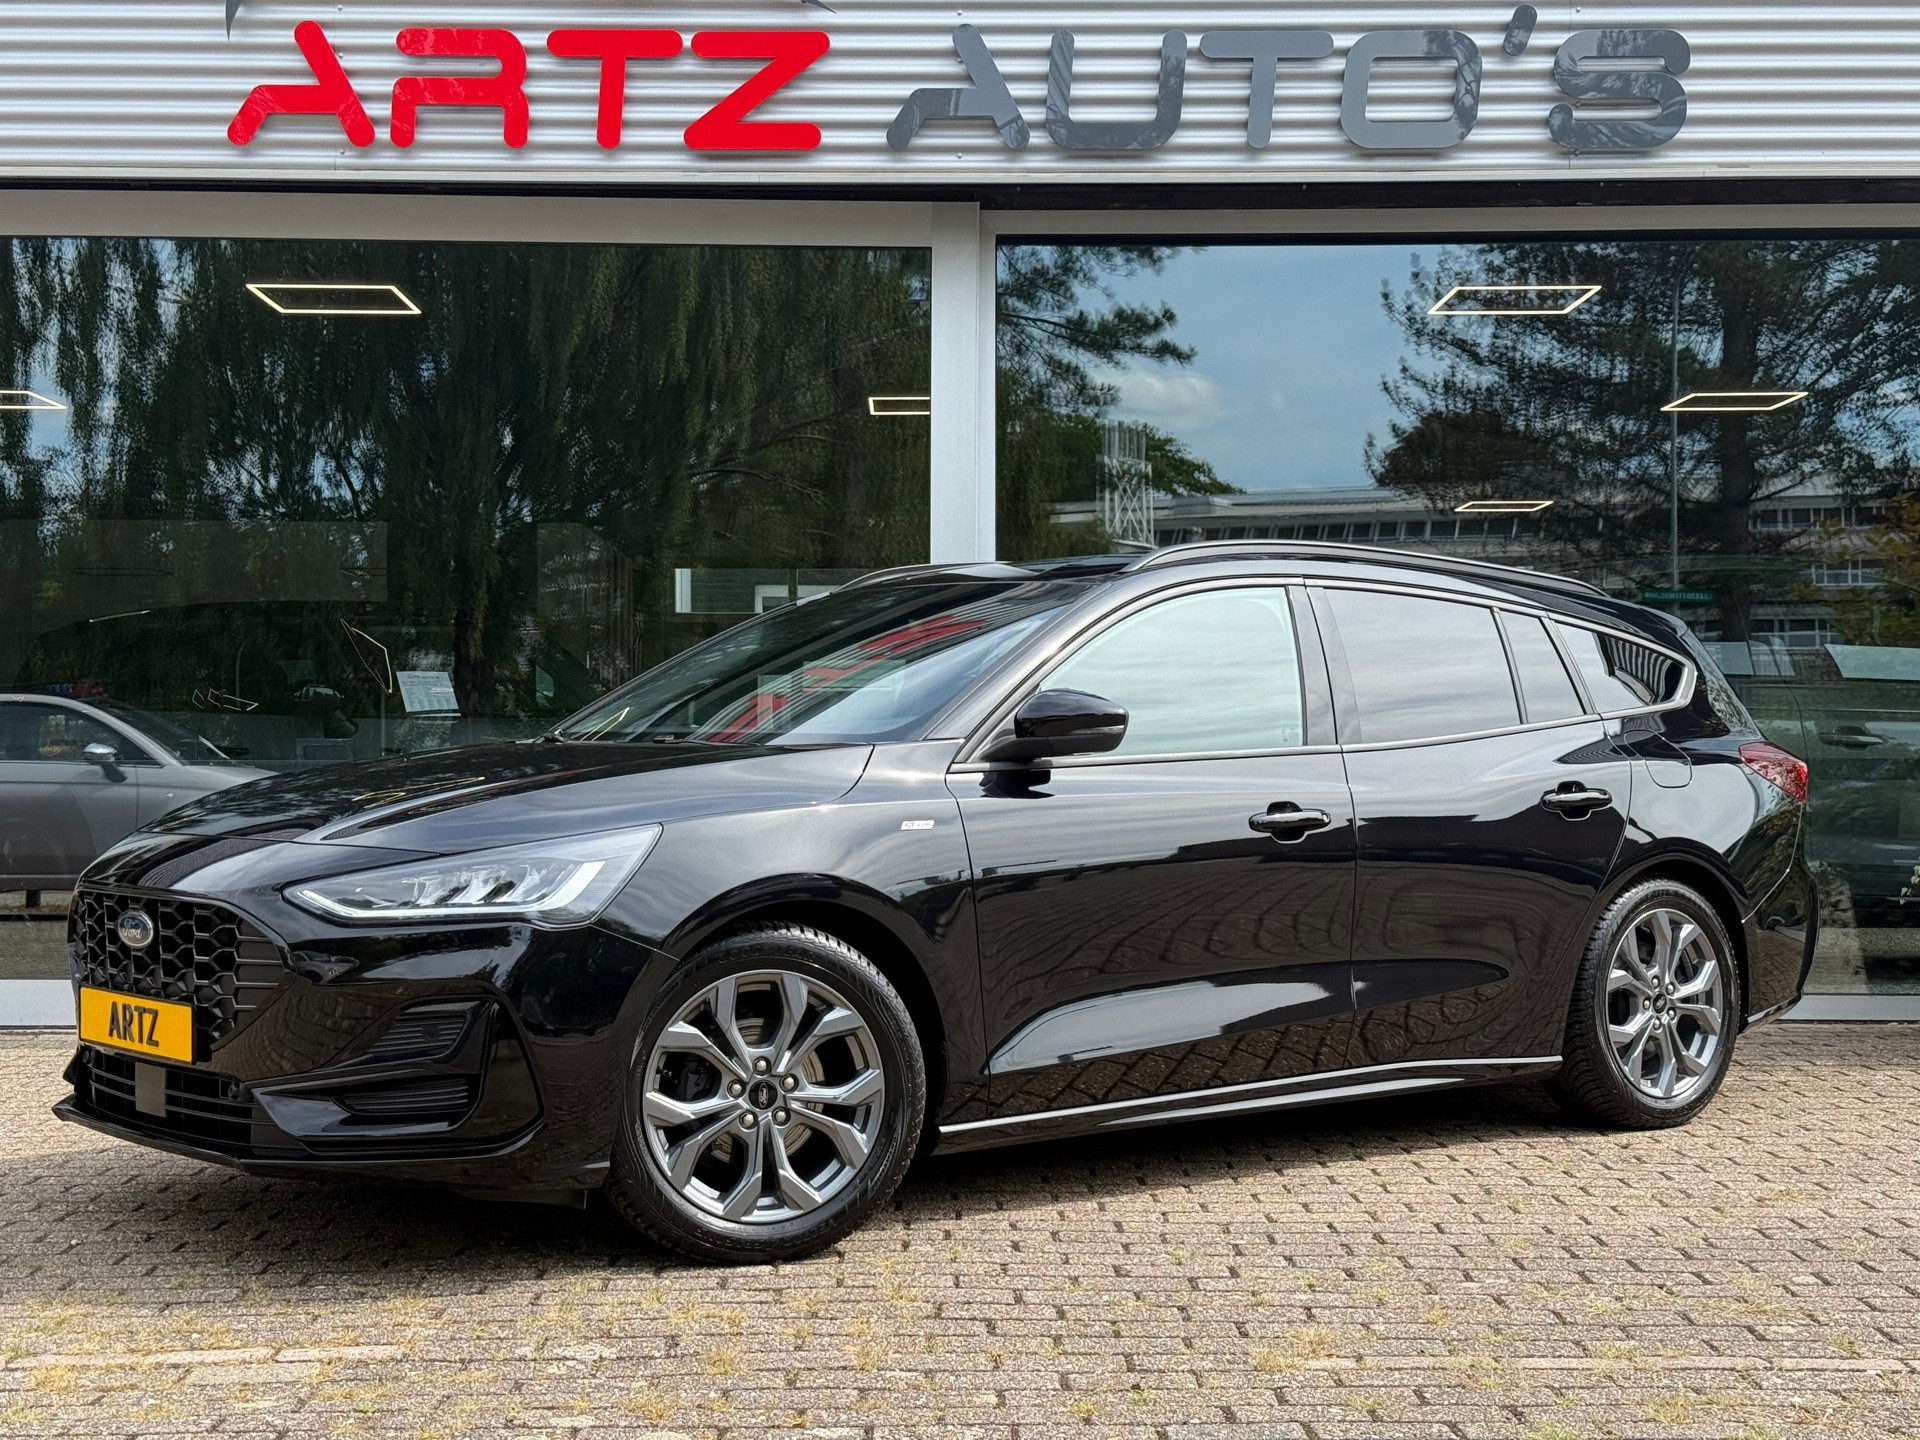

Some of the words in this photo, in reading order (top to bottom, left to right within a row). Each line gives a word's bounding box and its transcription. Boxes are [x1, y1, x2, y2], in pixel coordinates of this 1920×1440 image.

[227, 20, 830, 151] ARTZ
[886, 5, 1691, 151] AUTO'S
[108, 1001, 159, 1048] ARTZ
